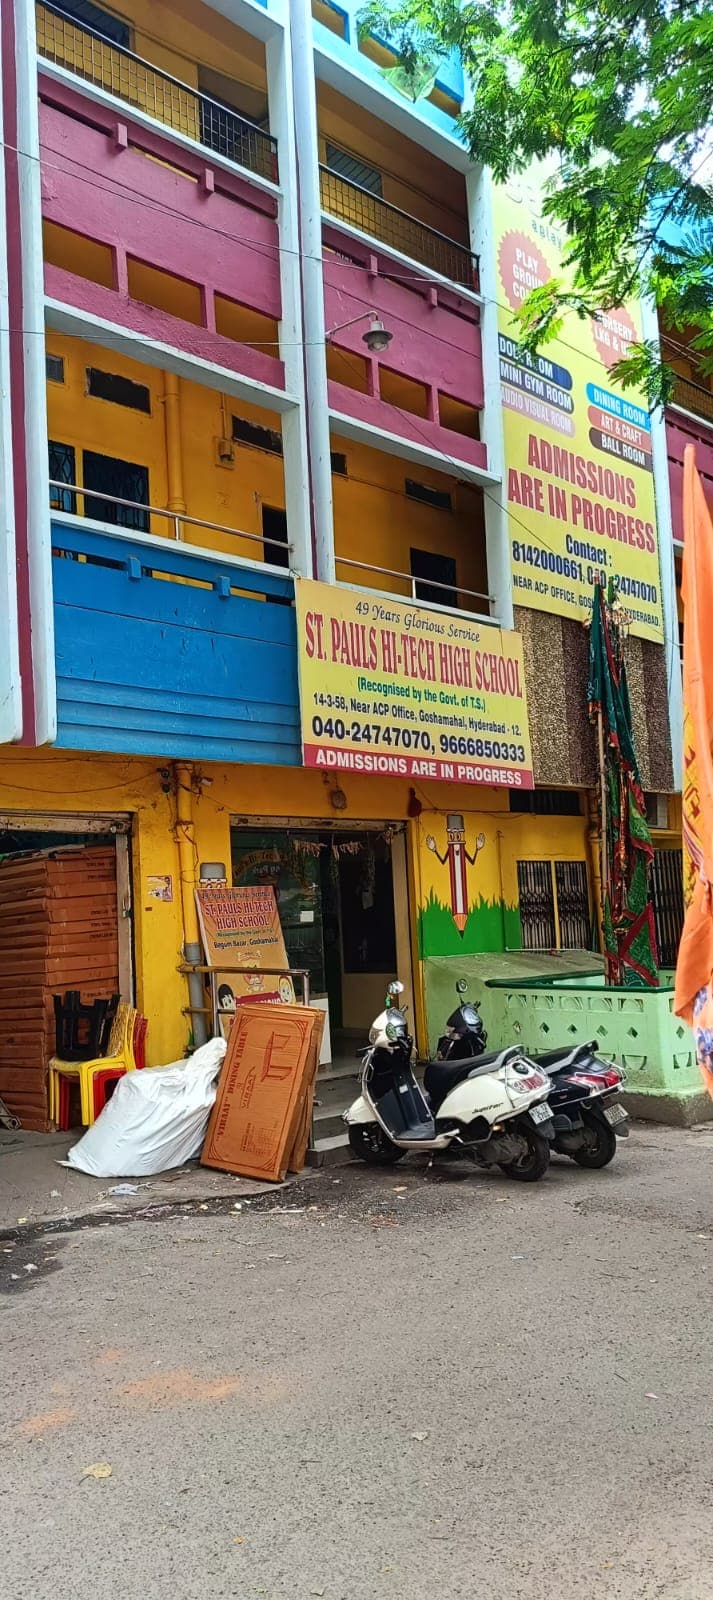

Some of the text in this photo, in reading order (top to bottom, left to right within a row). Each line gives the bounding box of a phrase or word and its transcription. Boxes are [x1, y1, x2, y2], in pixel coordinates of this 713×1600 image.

[515, 248, 538, 272] PLAY
[526, 350, 553, 378] ROM
[500, 361, 572, 411] MINI GYM ROOM
[525, 396, 549, 422] VISUAL
[551, 415, 572, 434] ROOM
[593, 389, 645, 427] DINING ROOM
[601, 415, 642, 445] ART & CRAFT
[601, 435, 646, 466] BALL ROOM
[527, 434, 637, 509] ADMISSIONS
[508, 468, 656, 554] ARE IN PROGRESS
[566, 533, 607, 564] Contact
[512, 540, 586, 585] 8142000661,
[587, 567, 607, 590] 00
[614, 574, 658, 604] 24747070
[513, 574, 533, 589] NEAR
[534, 581, 549, 598] ACP
[551, 585, 578, 605] OFFICE,
[355, 602, 480, 642] 49 Years Glorious Service
[305, 611, 523, 698] ST. PAULS HI-TECH HIGH SCHOOL
[357, 677, 486, 713] (Recognised by the Govt. of T.S.)
[313, 693, 349, 713] 14-3-58,
[350, 698, 371, 713] Near
[372, 703, 390, 716] ACP
[392, 705, 417, 722] Office,
[419, 711, 467, 729] Goshamahal,
[469, 717, 506, 734] Hyderabad
[511, 723, 522, 736] 12.
[312, 716, 525, 762] 040-24747070, 9666850333
[316, 750, 522, 785] ADMISSIONS ARE IN PROGRESS
[216, 915, 269, 930] HIGH SCHOOL
[217, 902, 242, 915] PAULS
[227, 1062, 240, 1094] DINING
[236, 1031, 248, 1058] TABLE
